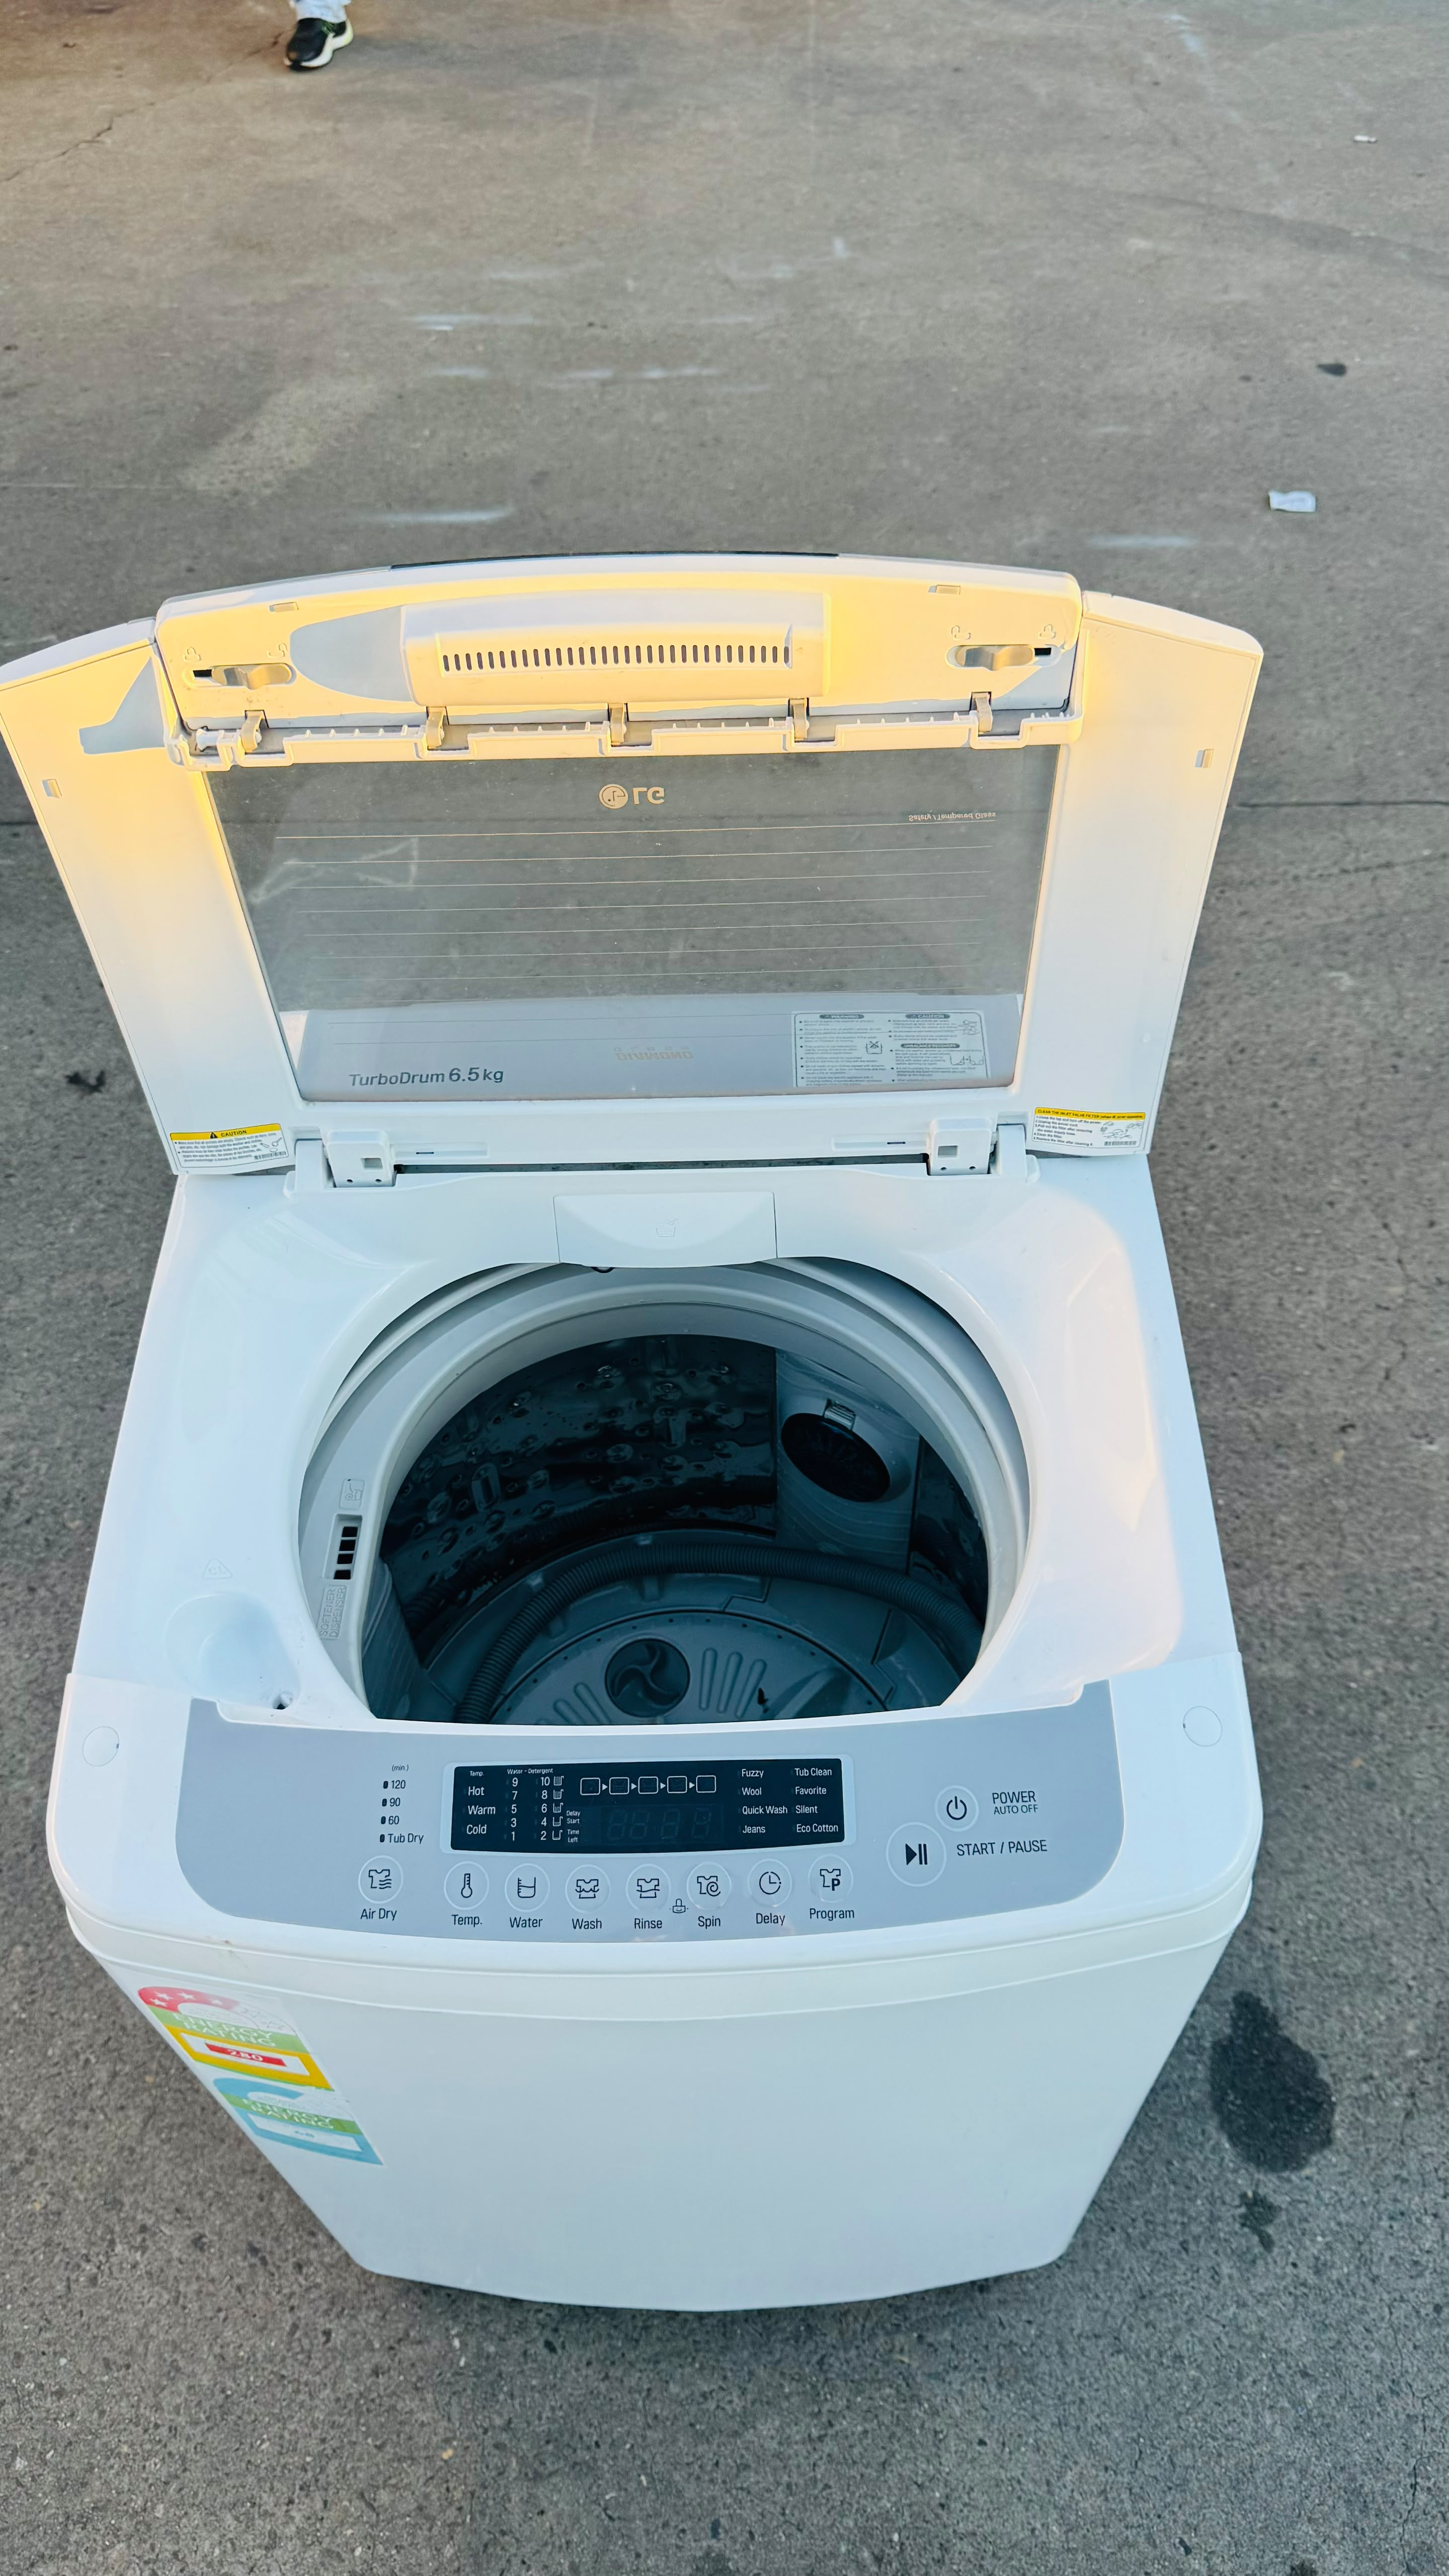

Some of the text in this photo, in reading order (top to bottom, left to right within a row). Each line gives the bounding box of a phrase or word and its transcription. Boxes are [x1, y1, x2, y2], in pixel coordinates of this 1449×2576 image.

[349, 1072, 445, 1086] TurboDrum
[319, 1589, 336, 1636] SOFTENER
[329, 1587, 346, 1638] DISPENSER
[741, 1768, 764, 1779] Fuzzy
[794, 1767, 832, 1776] Tub Clean
[391, 1780, 406, 1789] 120
[512, 1777, 518, 1787] 9
[540, 1776, 550, 1786] 10
[468, 1786, 485, 1796] Hot
[512, 1791, 518, 1800] 7
[541, 1790, 548, 1800] 8
[742, 1787, 762, 1795] Wool
[795, 1786, 827, 1795] Favorite
[389, 1797, 400, 1807] 90
[992, 1790, 1036, 1804] POWER
[468, 1805, 496, 1815] Warm
[511, 1804, 517, 1814] 5
[541, 1803, 547, 1813] 6
[742, 1805, 788, 1815] Quick Wash
[795, 1805, 818, 1814] Silent
[994, 1804, 1039, 1815] AUTO OFF
[388, 1815, 399, 1825] 60
[511, 1818, 517, 1827] 3
[541, 1817, 547, 1826] 4
[466, 1824, 487, 1834] Cold
[743, 1825, 766, 1833] Jeans
[796, 1823, 838, 1832] Eco Cotton
[387, 1833, 424, 1844] Tub Dry
[511, 1831, 515, 1841] 1
[540, 1830, 547, 1840] 2
[956, 1841, 996, 1857] START
[1008, 1839, 1048, 1854] PAUSE
[360, 1908, 397, 1922] Air Dry
[756, 1912, 785, 1926] Delay
[809, 1908, 855, 1921] Program
[451, 1914, 483, 1927] Temp.
[509, 1916, 543, 1928] Water
[572, 1918, 603, 1930] Wash
[634, 1918, 663, 1929] Rinse
[697, 1915, 721, 1929] Spin
[172, 2013, 273, 2039] ENERGY
[183, 2022, 276, 2047] RATING
